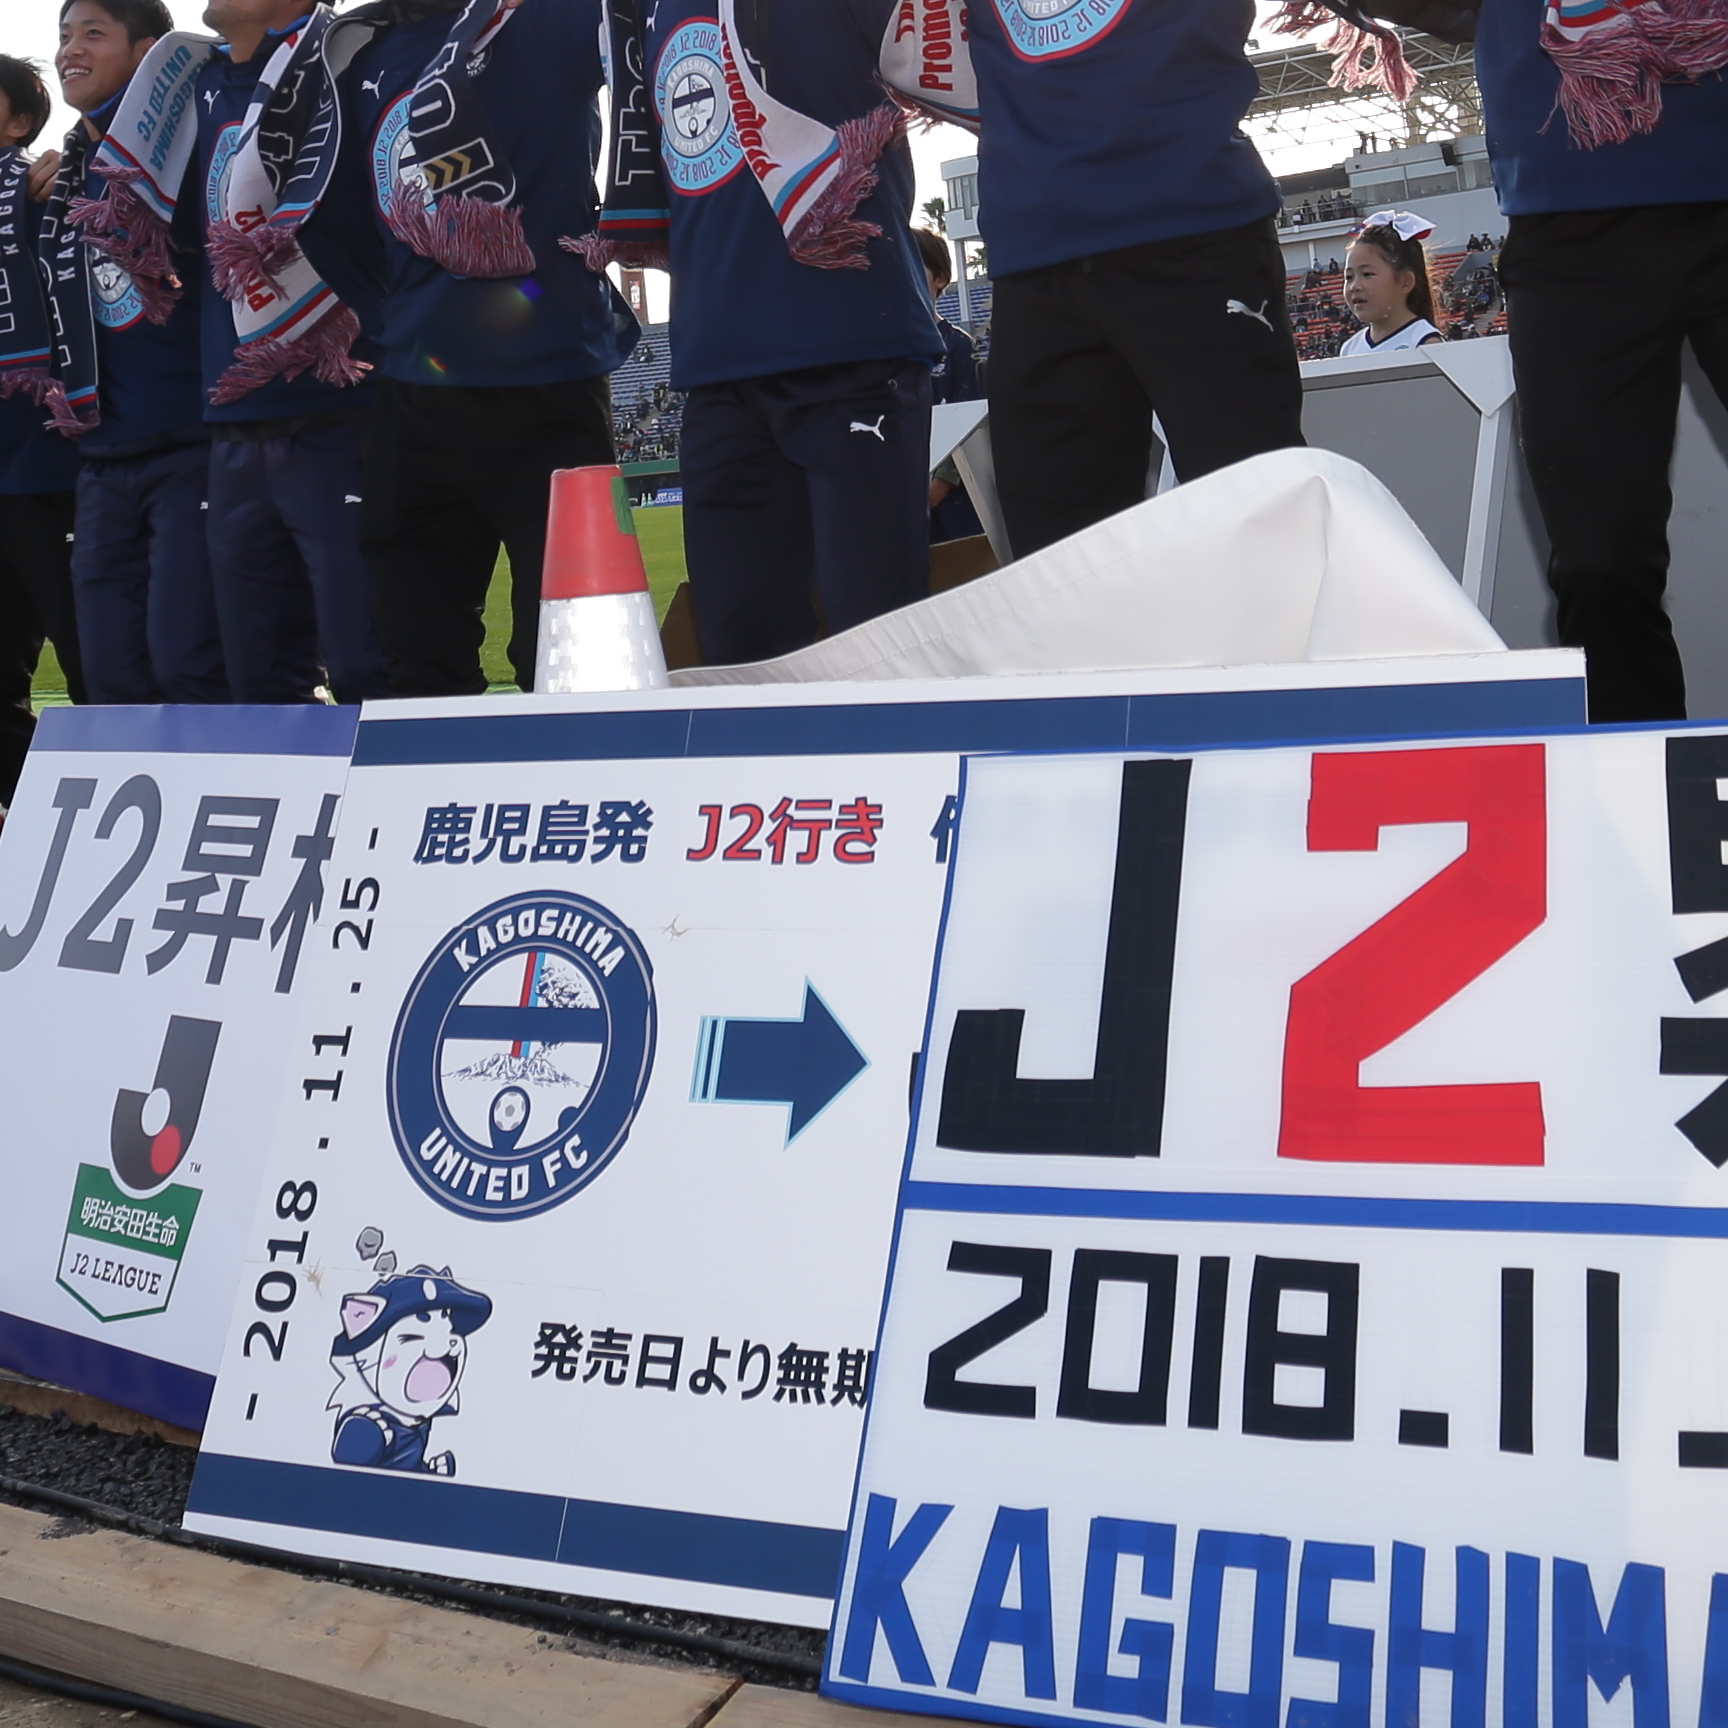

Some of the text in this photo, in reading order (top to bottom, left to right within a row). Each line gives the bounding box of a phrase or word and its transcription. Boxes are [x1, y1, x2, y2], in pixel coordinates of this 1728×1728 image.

[680, 33, 690, 52] J2
[693, 30, 717, 55] 2018
[1038, 20, 1072, 47] 2018
[1072, 8, 1094, 33] J2
[135, 44, 193, 143] UNITED FC
[376, 110, 403, 190] 2018 J2 2018
[674, 125, 718, 152] UNITED FC
[679, 146, 732, 182] J2 2018 J2
[412, 800, 654, 864] 鹿児島発
[685, 795, 885, 865] J2行き
[452, 908, 626, 978] KAGOSHIMA
[419, 1127, 589, 1202] UNITED FC
[79, 1196, 180, 1247] 明治安田生命
[69, 1252, 163, 1296] J2 LEAGUE
[530, 1321, 876, 1410] 発売日より無期
